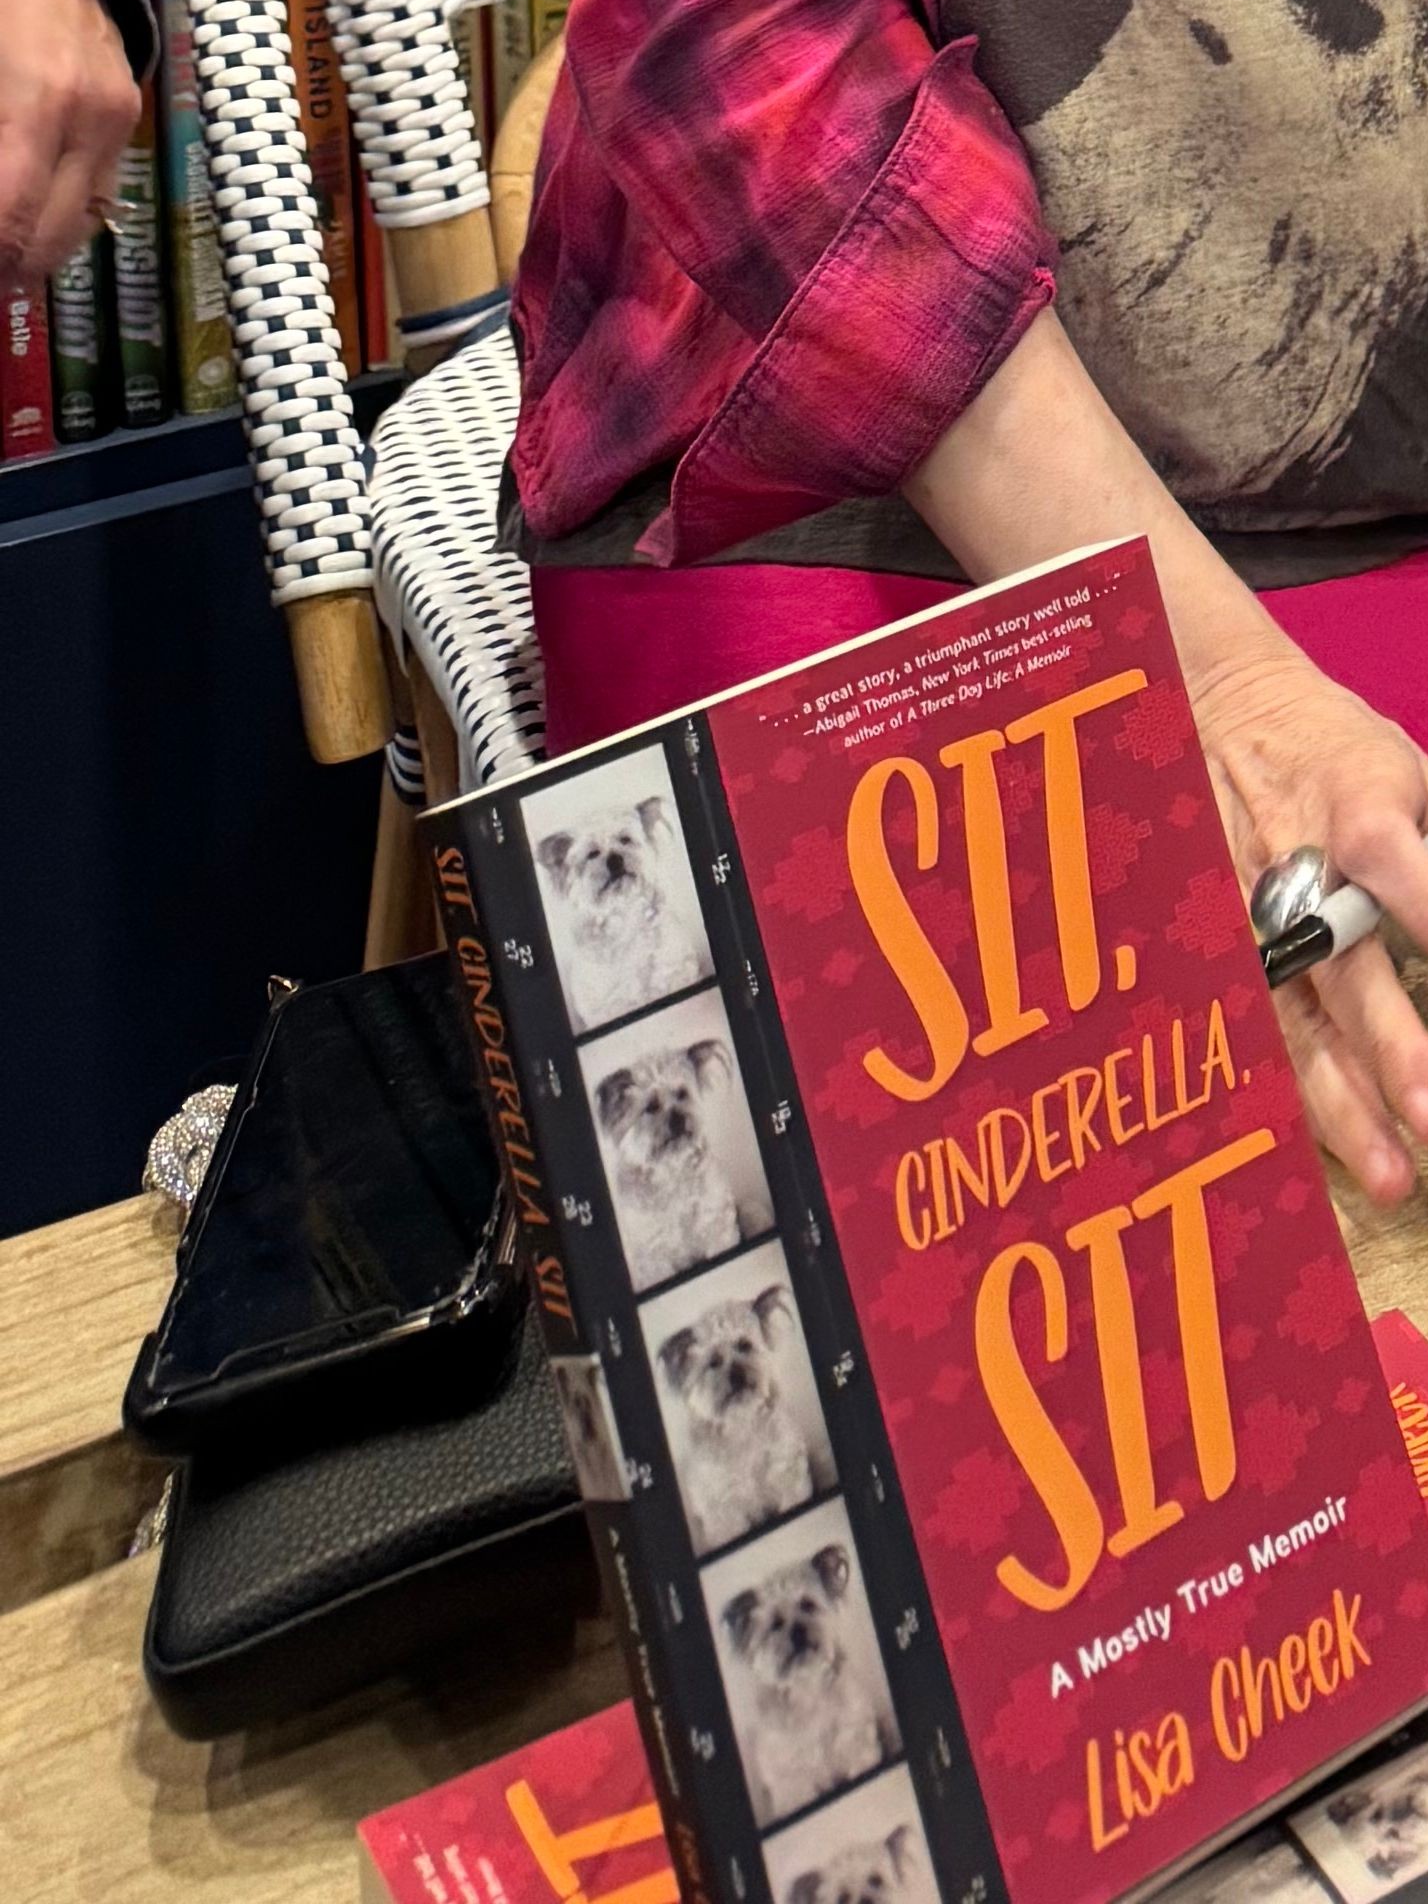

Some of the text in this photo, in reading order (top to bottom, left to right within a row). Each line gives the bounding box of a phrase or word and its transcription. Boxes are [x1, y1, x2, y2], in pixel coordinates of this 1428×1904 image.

[802, 587, 1090, 714] a great story, a triumphant story well told
[843, 721, 885, 748] author
[889, 711, 904, 728] of
[906, 708, 918, 721] A
[920, 693, 956, 718] Three
[958, 680, 983, 702] Dog
[1014, 663, 1024, 678] A
[1026, 645, 1072, 673] Memoir
[863, 684, 920, 721] Thomas,
[921, 671, 950, 693] New
[952, 656, 981, 678] York
[982, 642, 1020, 666] Times
[1021, 612, 1093, 652] best-selling
[533, 1251, 578, 1337] SIT
[973, 1127, 1278, 1613] SIT
[1048, 1493, 1349, 1699] A Mostly True Memoir
[1086, 1589, 1372, 1853] Lisa Cheek
